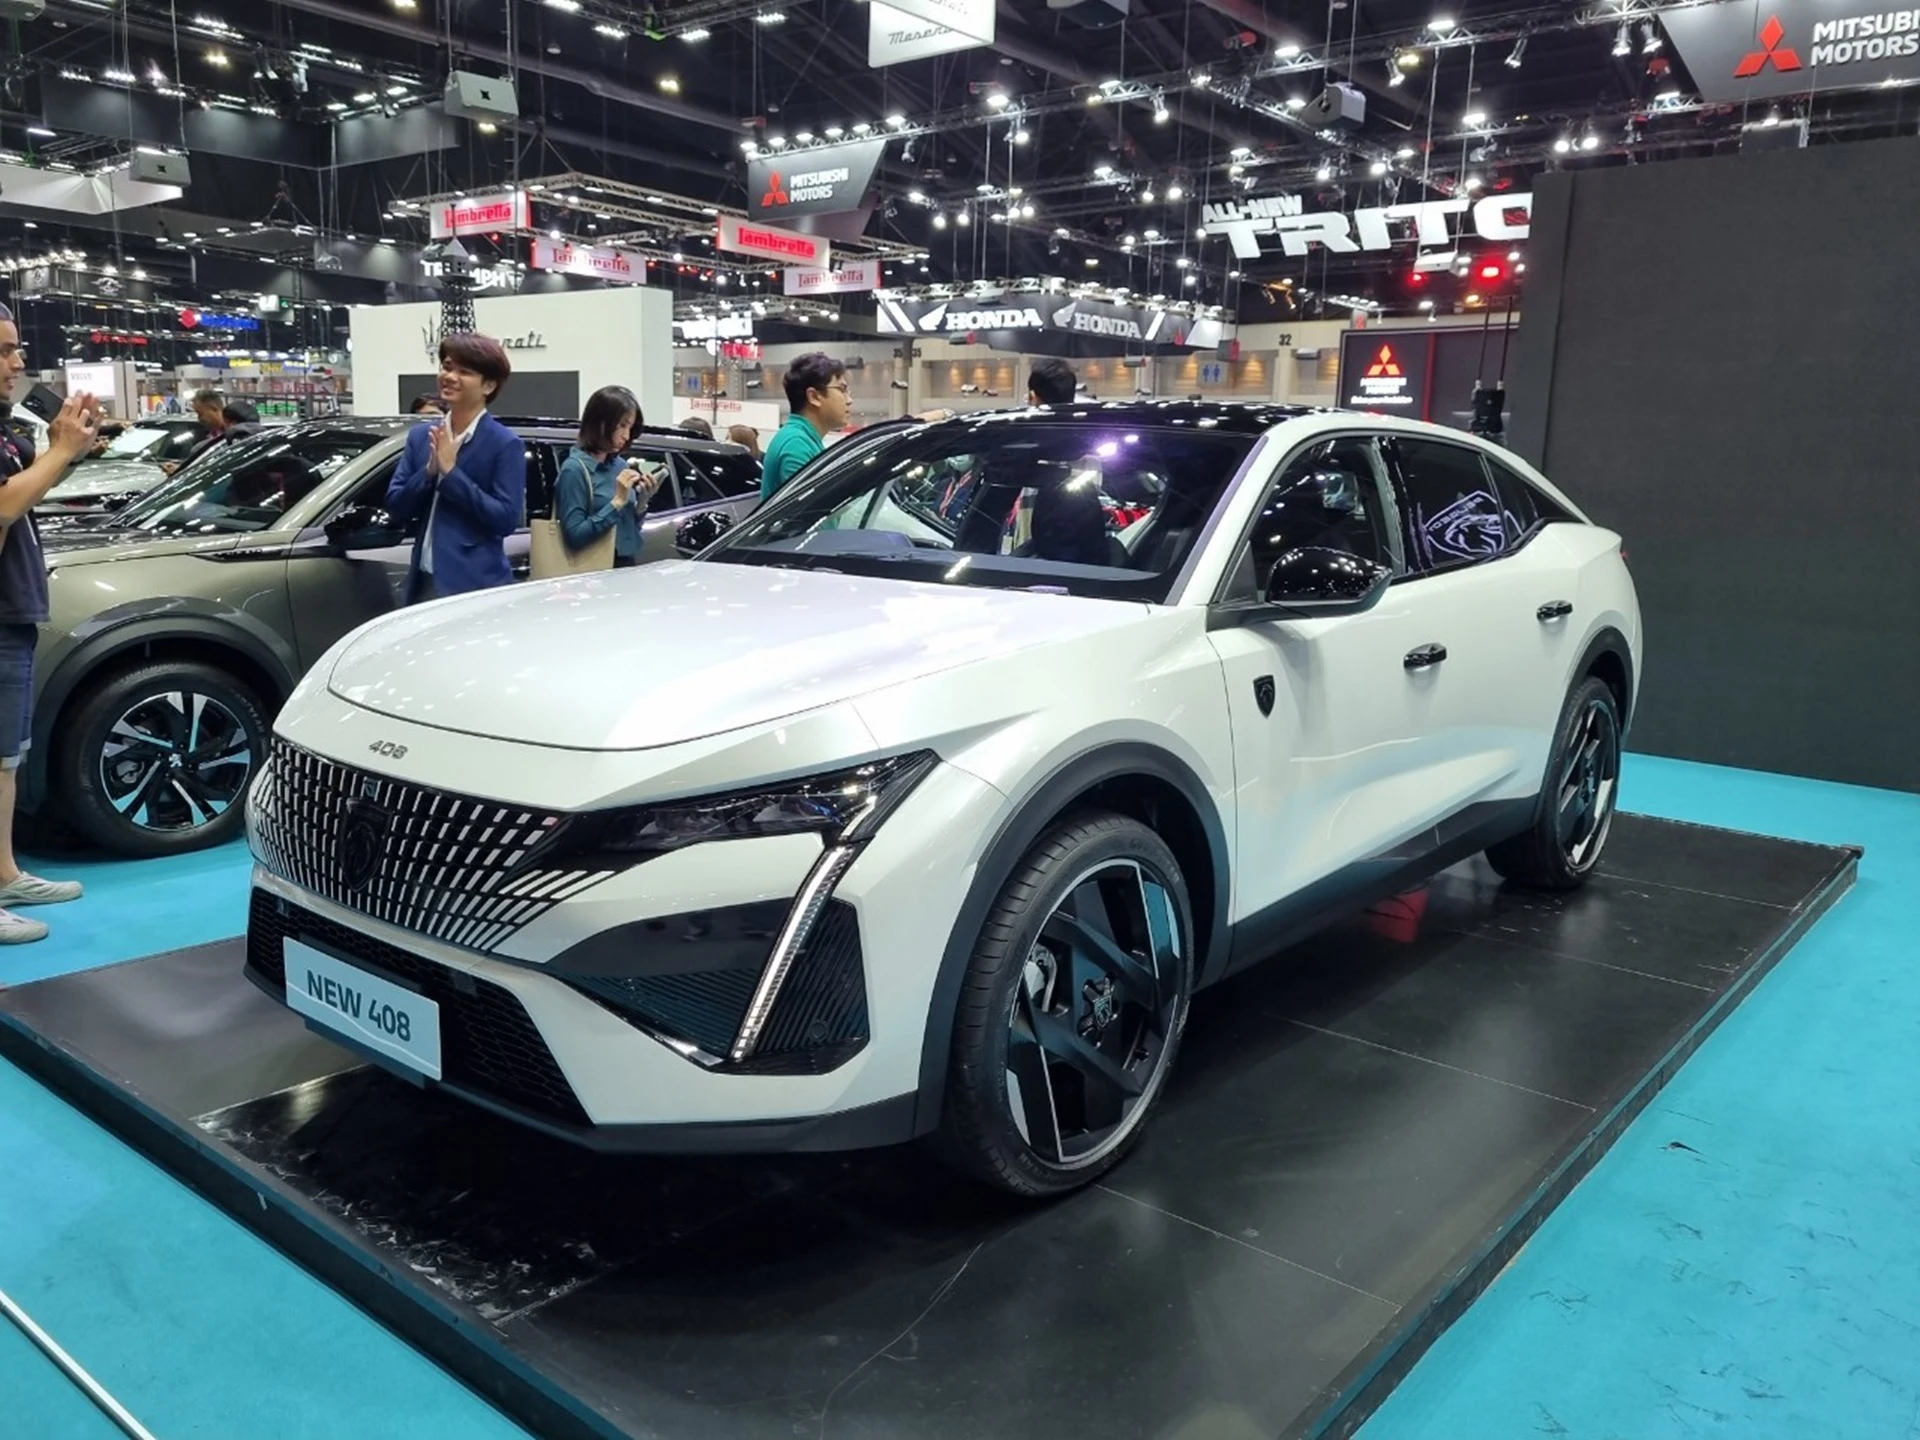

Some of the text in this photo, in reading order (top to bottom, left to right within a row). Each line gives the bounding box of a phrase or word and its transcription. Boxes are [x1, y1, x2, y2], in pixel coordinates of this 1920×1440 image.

[1809, 33, 1919, 67] MOTORS
[790, 167, 849, 189] MITSUBISHI
[790, 185, 834, 203] MOTORS
[1203, 195, 1302, 223] ALL-NEW
[945, 308, 1044, 330] HONDA
[1073, 312, 1143, 339] HONDA
[1278, 333, 1293, 346] 32
[369, 740, 408, 760] 408
[306, 970, 411, 1042] NEW 408
